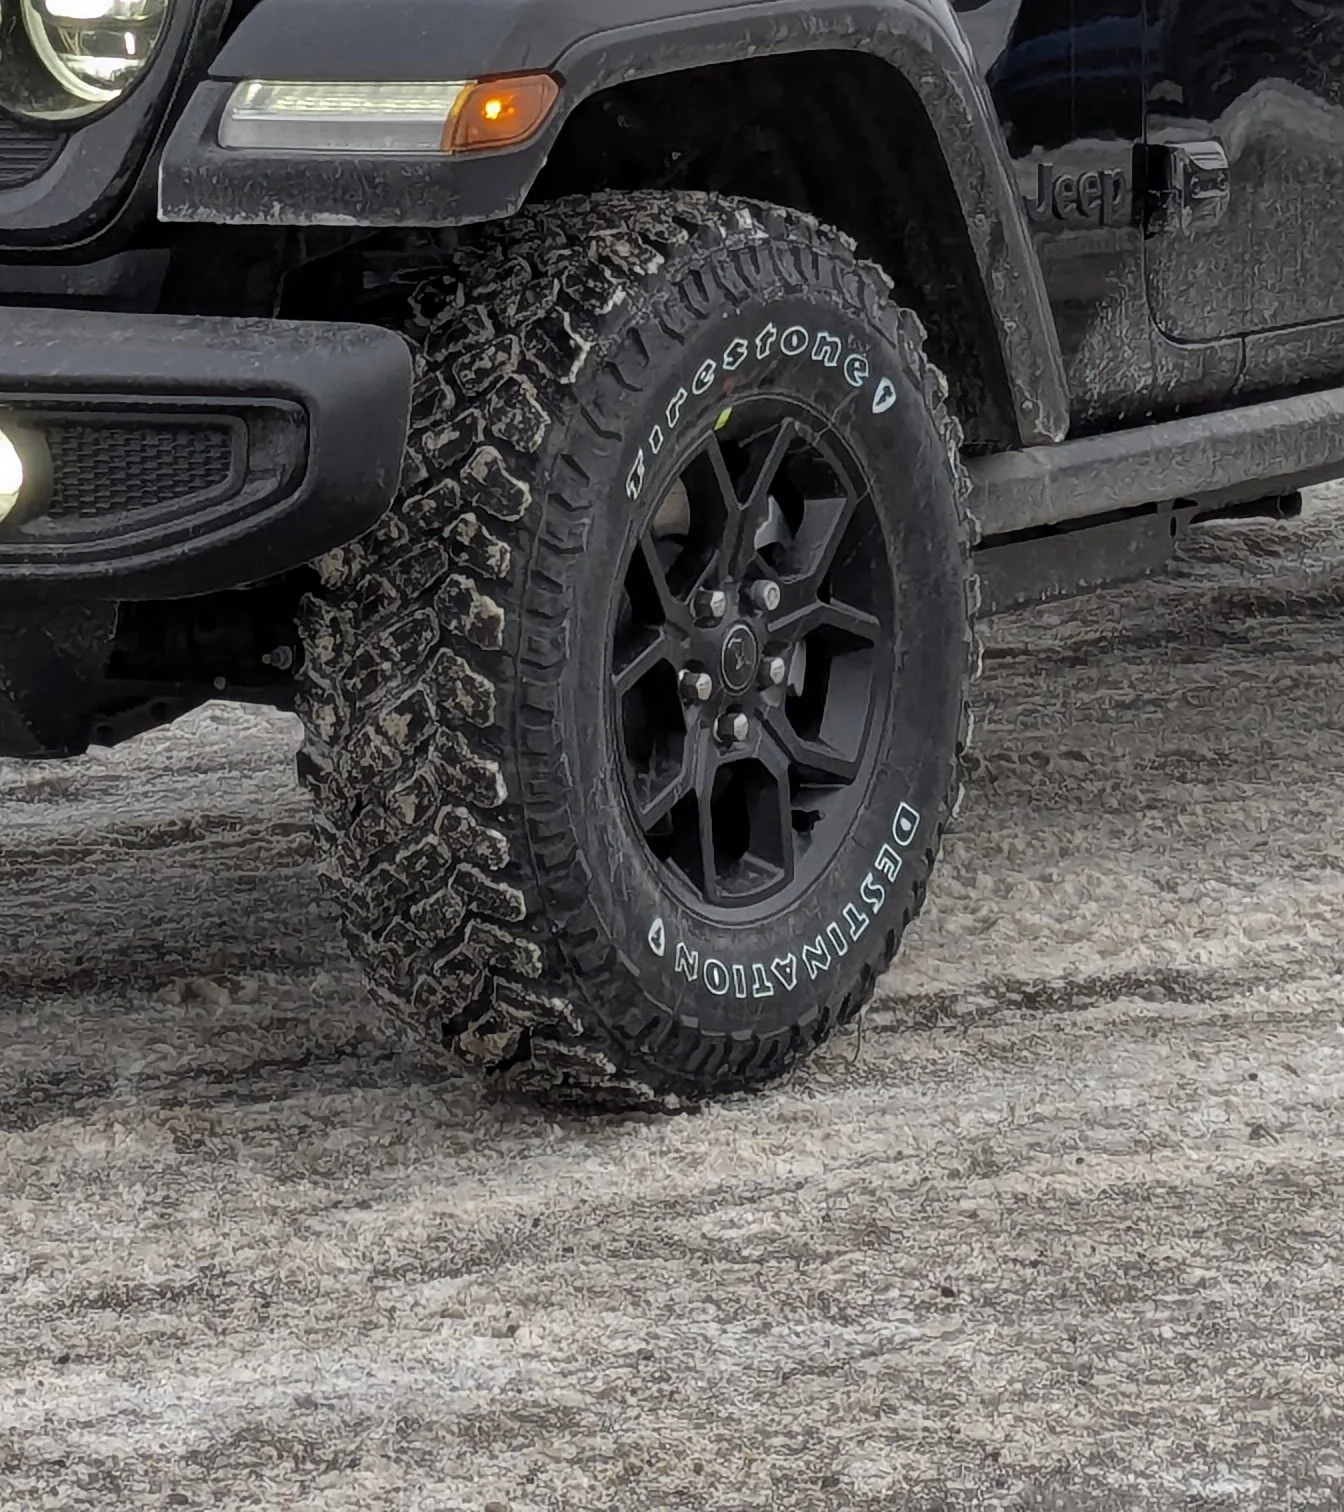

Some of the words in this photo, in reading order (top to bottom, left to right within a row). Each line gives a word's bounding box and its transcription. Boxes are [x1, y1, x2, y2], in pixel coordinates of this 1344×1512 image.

[1028, 162, 1126, 226] Jeep
[626, 323, 870, 503] Firestone
[674, 801, 921, 999] DESTINATION
